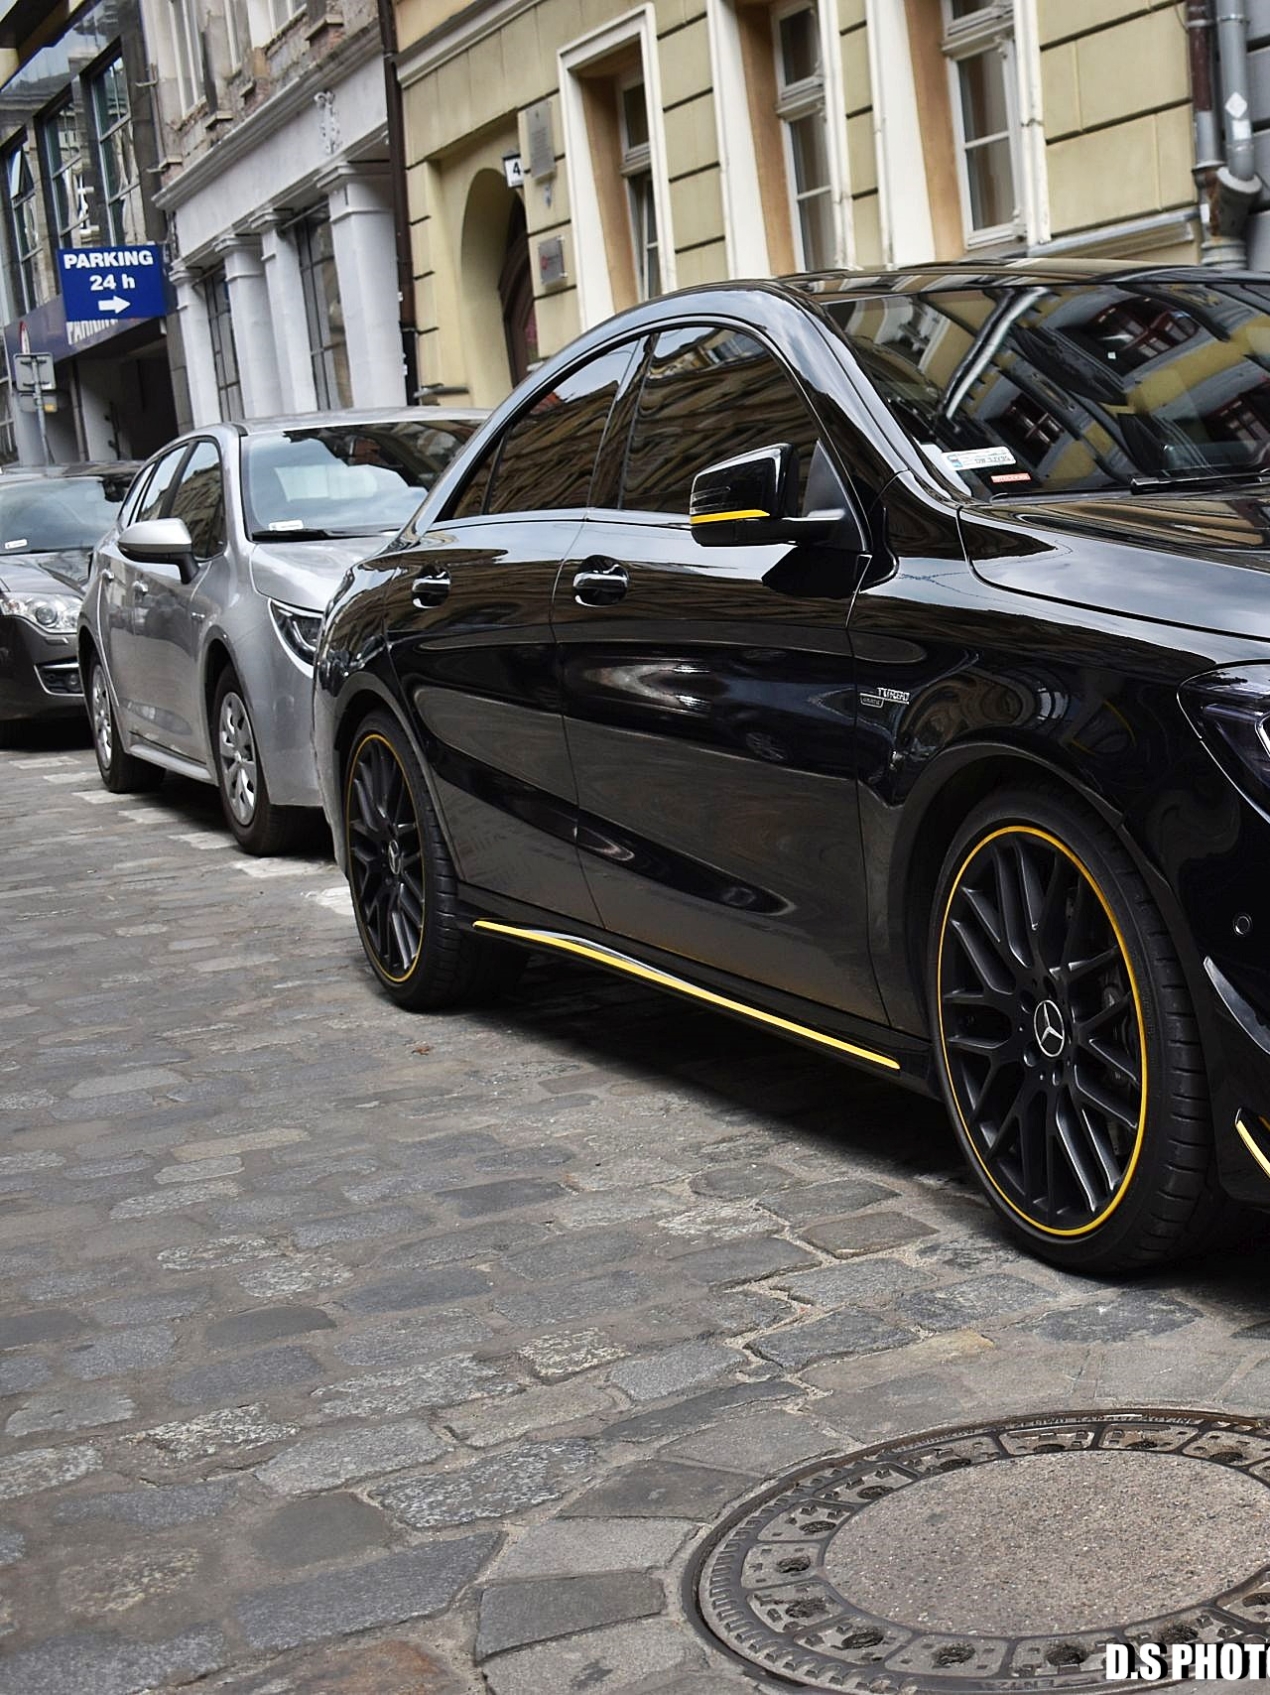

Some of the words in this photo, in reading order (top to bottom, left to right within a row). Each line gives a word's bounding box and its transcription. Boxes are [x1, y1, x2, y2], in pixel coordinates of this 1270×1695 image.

[512, 161, 521, 176] 4
[64, 250, 153, 269] PARKING
[90, 275, 116, 291] 24
[122, 274, 135, 289] h
